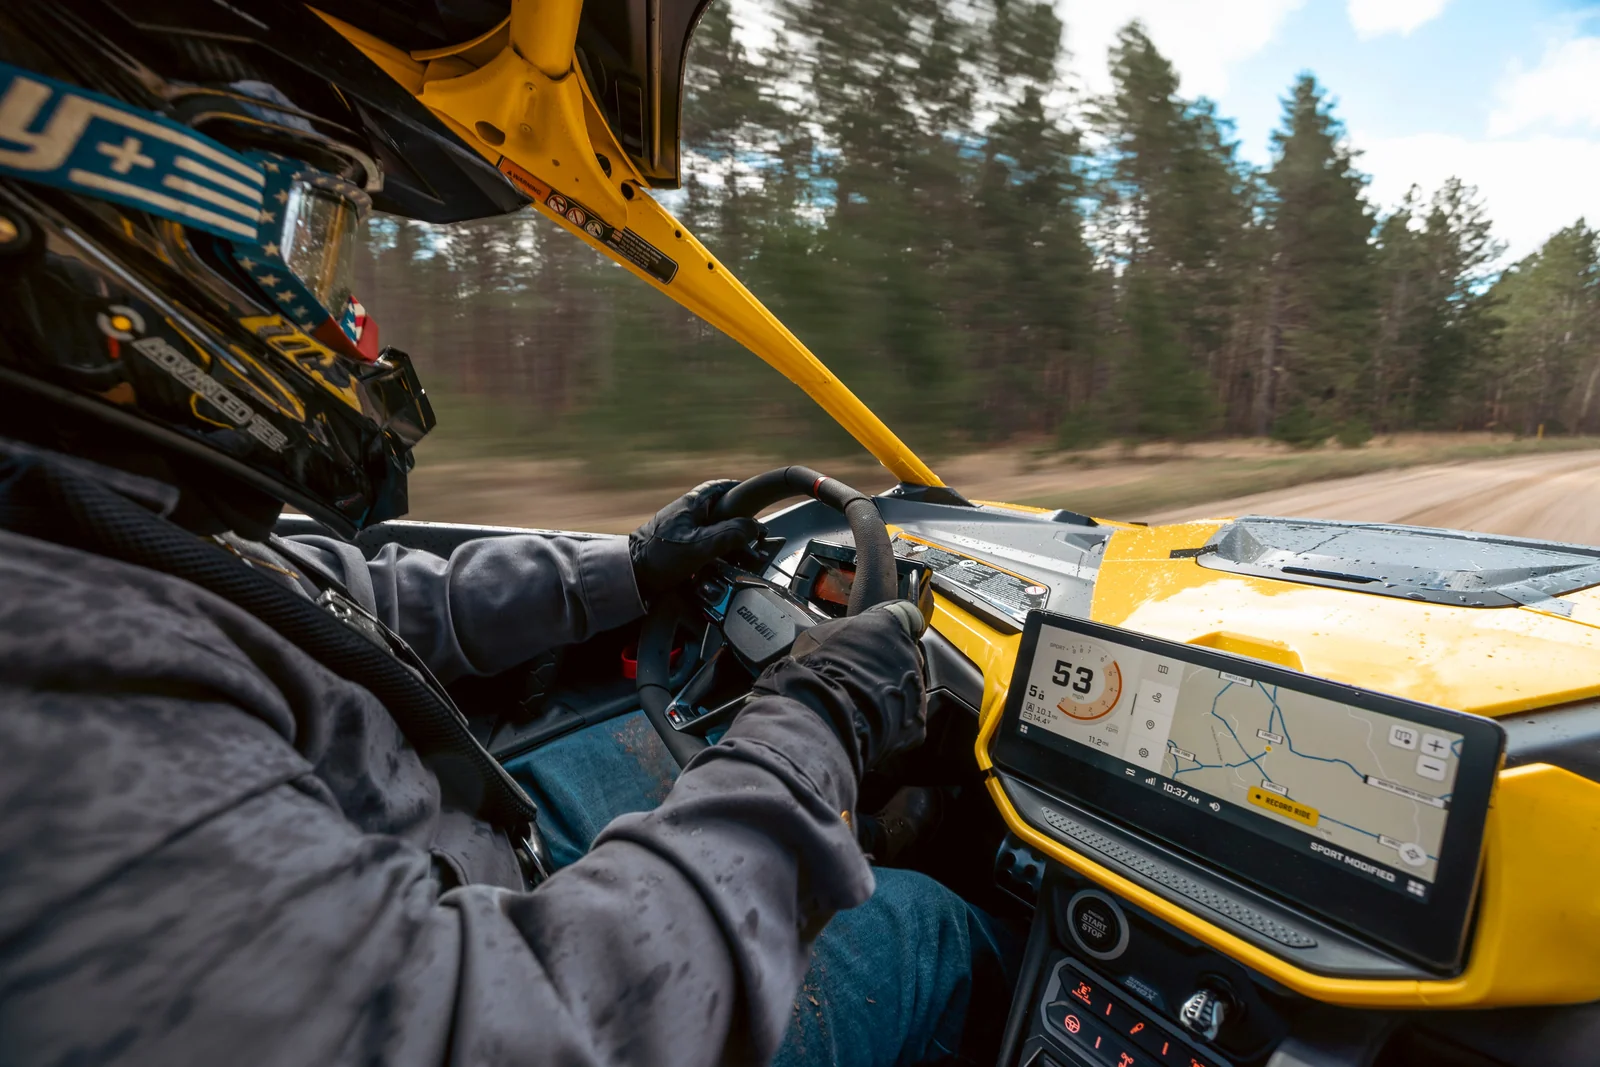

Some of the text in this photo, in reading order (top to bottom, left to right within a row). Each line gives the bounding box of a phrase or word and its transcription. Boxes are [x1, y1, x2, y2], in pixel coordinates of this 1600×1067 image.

[513, 173, 542, 196] WARNING
[132, 336, 252, 426] ADVANCED
[1050, 642, 1065, 651] SPORT
[1052, 660, 1093, 694] 53
[1029, 684, 1038, 697] 5
[1162, 782, 1199, 804] 10:37 AM
[1265, 797, 1311, 819] RECORD RIDE
[1310, 842, 1396, 882] SPORT MODIFIED
[1082, 913, 1107, 932] START
[1082, 923, 1102, 938] STOP
